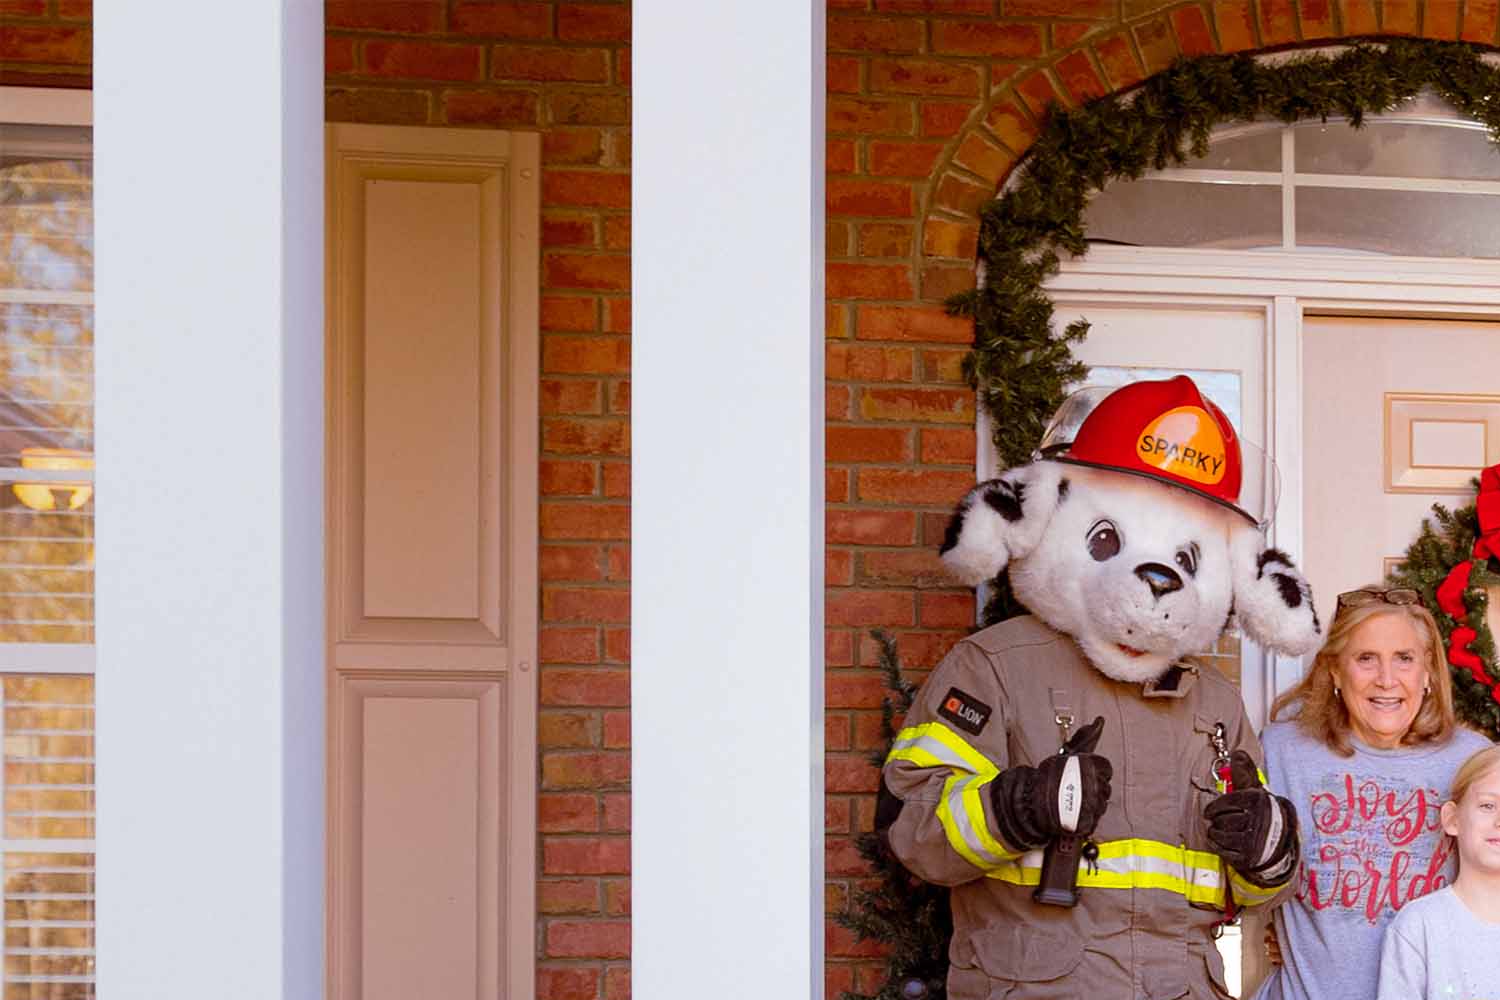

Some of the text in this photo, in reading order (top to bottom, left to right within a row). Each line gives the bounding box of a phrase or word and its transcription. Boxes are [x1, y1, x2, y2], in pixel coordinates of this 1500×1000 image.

[1140, 435, 1222, 475] SPARKY
[958, 700, 985, 726] LION
[1311, 774, 1442, 846] Joy
[1294, 843, 1448, 922] World
